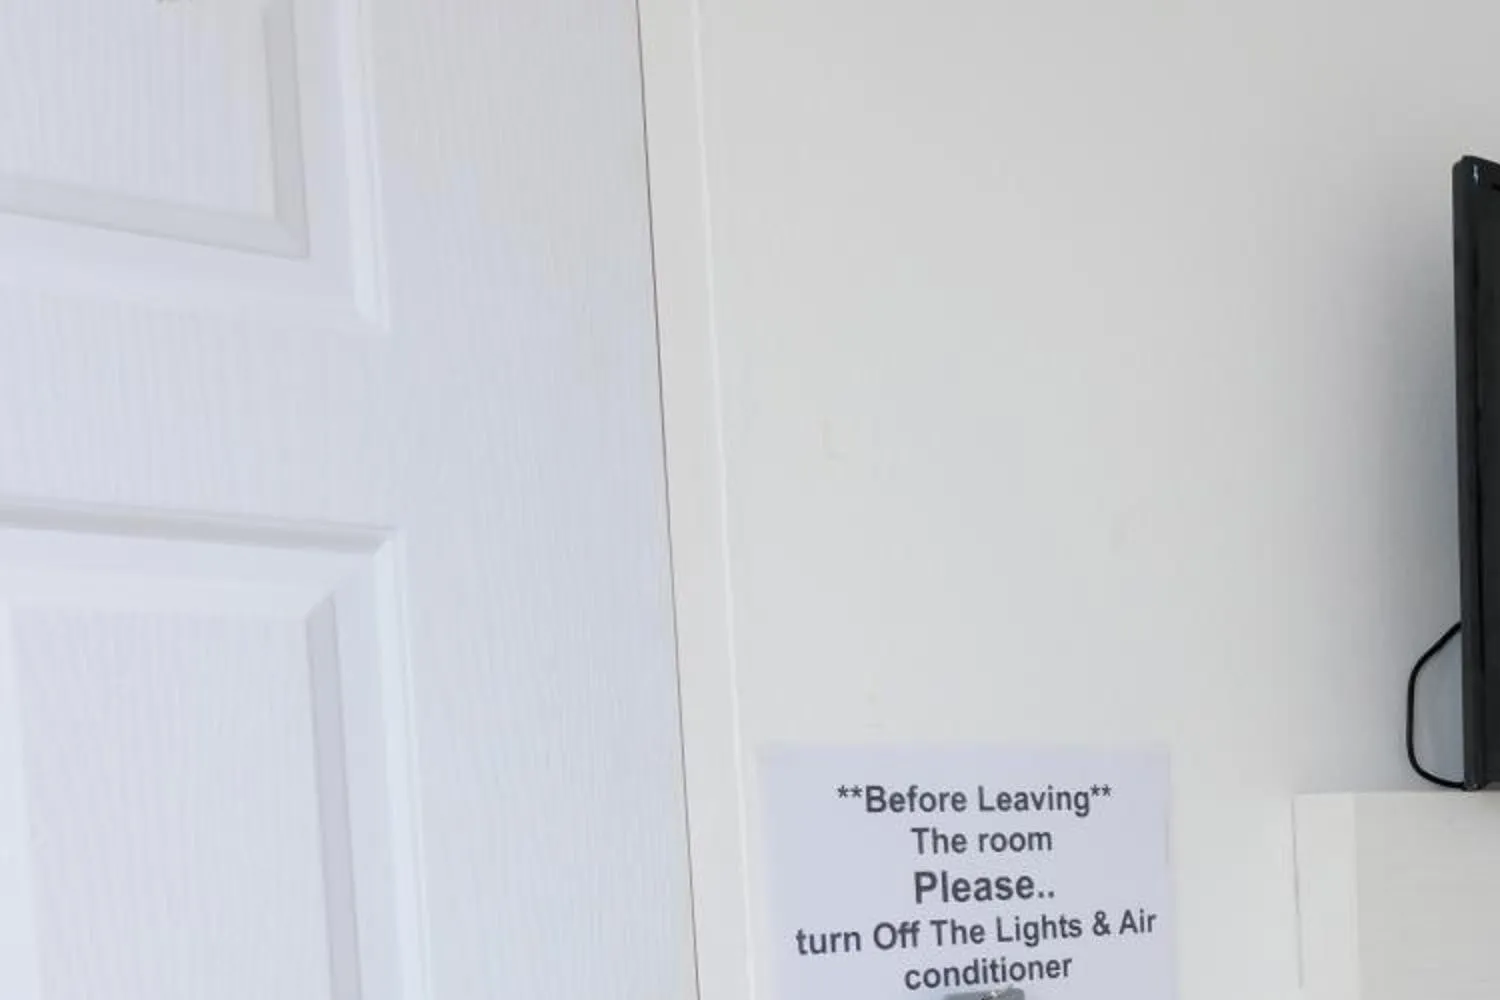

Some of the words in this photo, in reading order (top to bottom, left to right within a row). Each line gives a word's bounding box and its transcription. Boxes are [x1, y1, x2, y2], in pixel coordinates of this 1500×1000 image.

[911, 828, 967, 854] The
[979, 832, 1052, 852] room
[915, 870, 1054, 904] Please..
[796, 929, 861, 955] turn
[874, 920, 920, 950] Off
[930, 919, 985, 946] The
[996, 915, 1082, 947] Lights
[1092, 911, 1111, 936] &
[1119, 909, 1156, 934] Air
[905, 955, 1072, 989] conditioner
